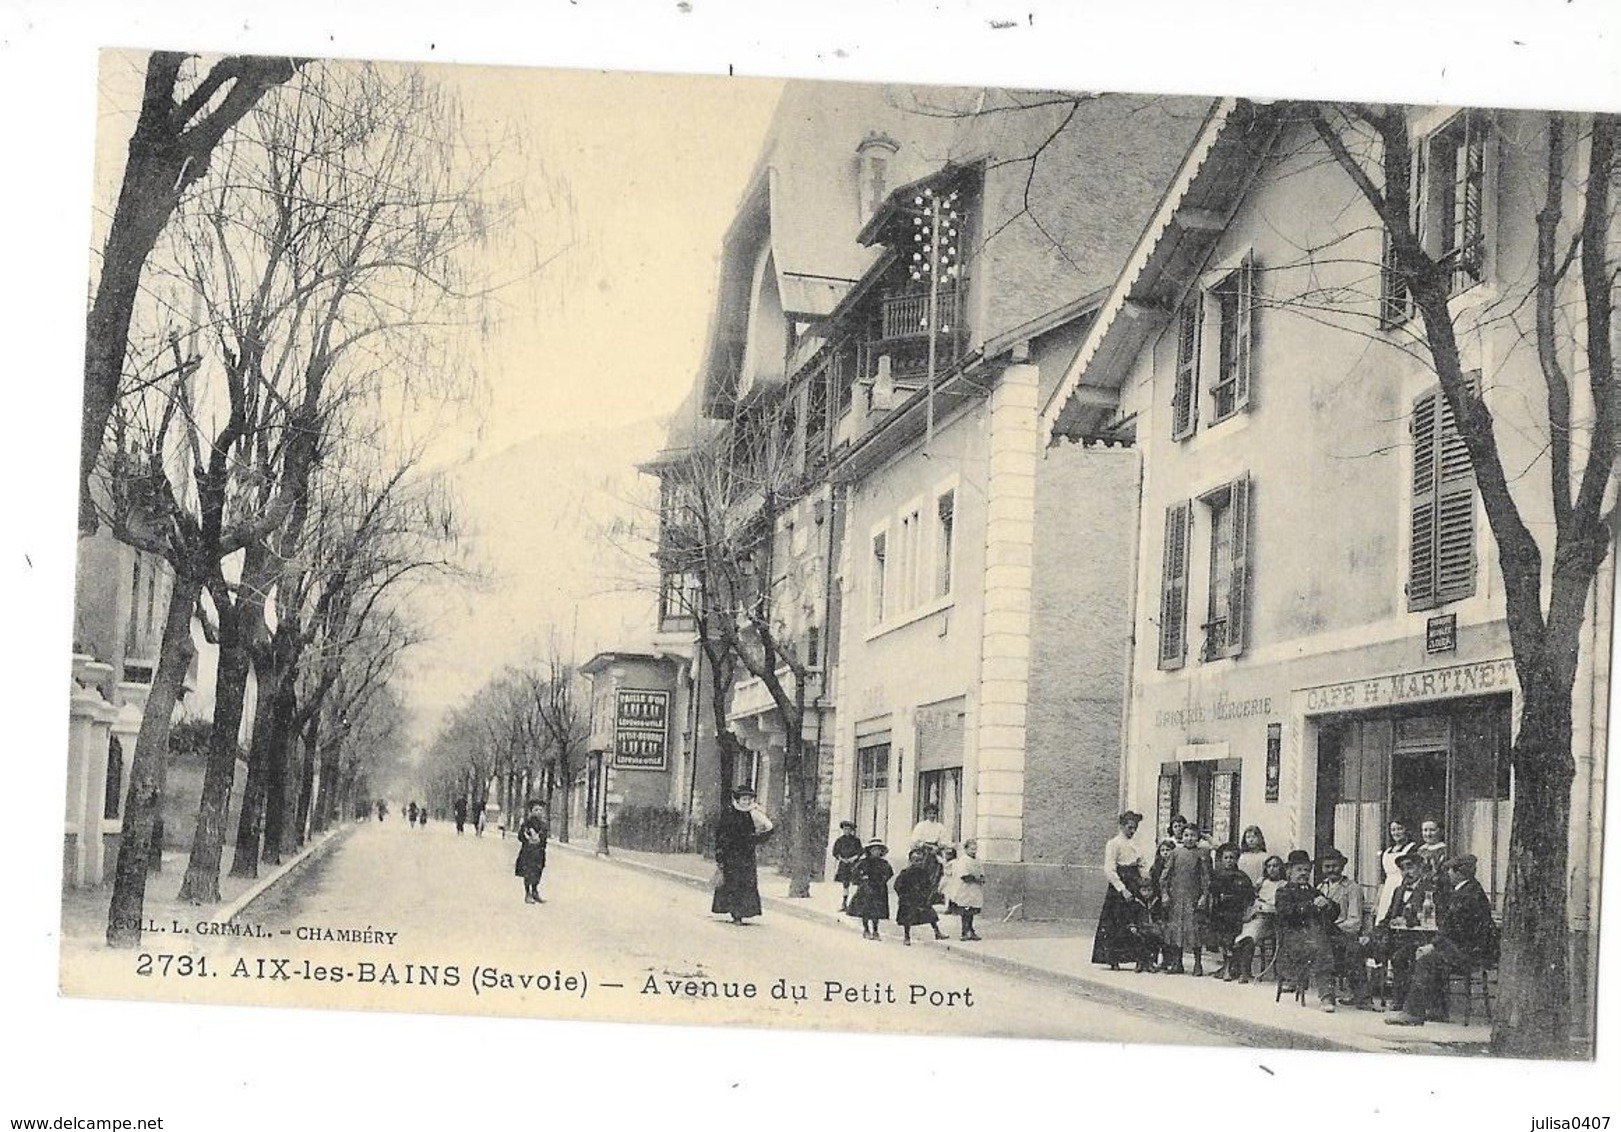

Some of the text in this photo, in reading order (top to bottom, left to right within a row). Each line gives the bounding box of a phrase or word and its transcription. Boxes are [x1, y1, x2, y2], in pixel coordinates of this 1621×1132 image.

[1388, 661, 1513, 703] MARTINET
[623, 703, 659, 718] LU LU
[622, 741, 657, 755] LU LU
